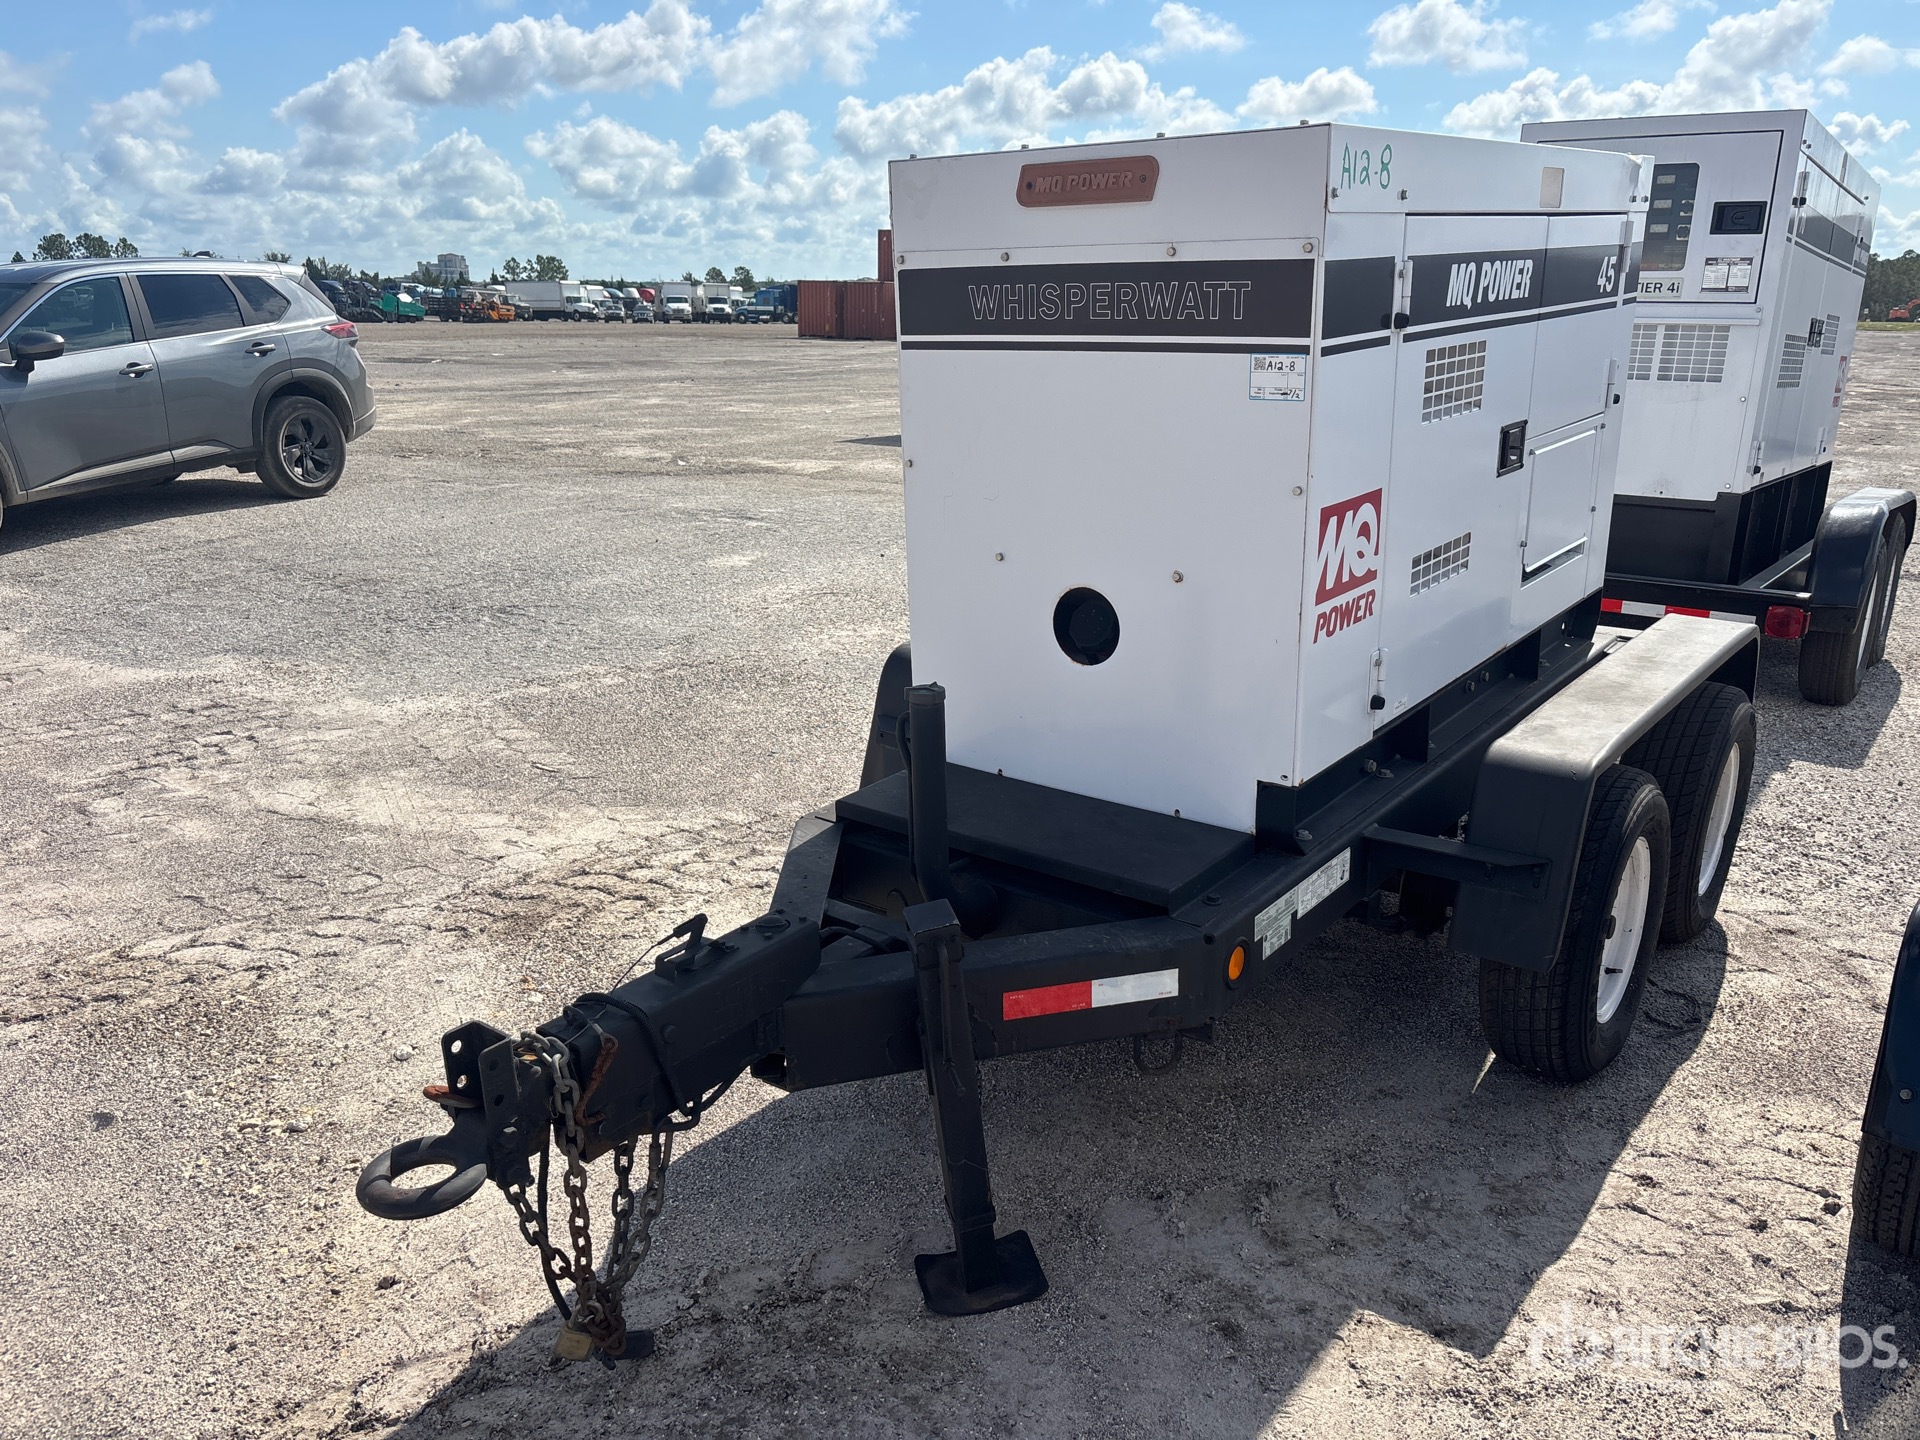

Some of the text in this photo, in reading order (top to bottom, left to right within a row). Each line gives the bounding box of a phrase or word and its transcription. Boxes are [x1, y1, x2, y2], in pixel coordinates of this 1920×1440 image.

[1035, 171, 1133, 194] MQ POWER
[1341, 142, 1393, 190] A12-8
[1446, 259, 1533, 310] MQ POWER
[1597, 256, 1617, 293] 45
[1667, 282, 1680, 293] 4i
[968, 281, 1251, 320] WHISPERWATT
[1266, 360, 1296, 372] A12-8
[1315, 501, 1380, 594] MQ
[1313, 589, 1376, 645] POWER
